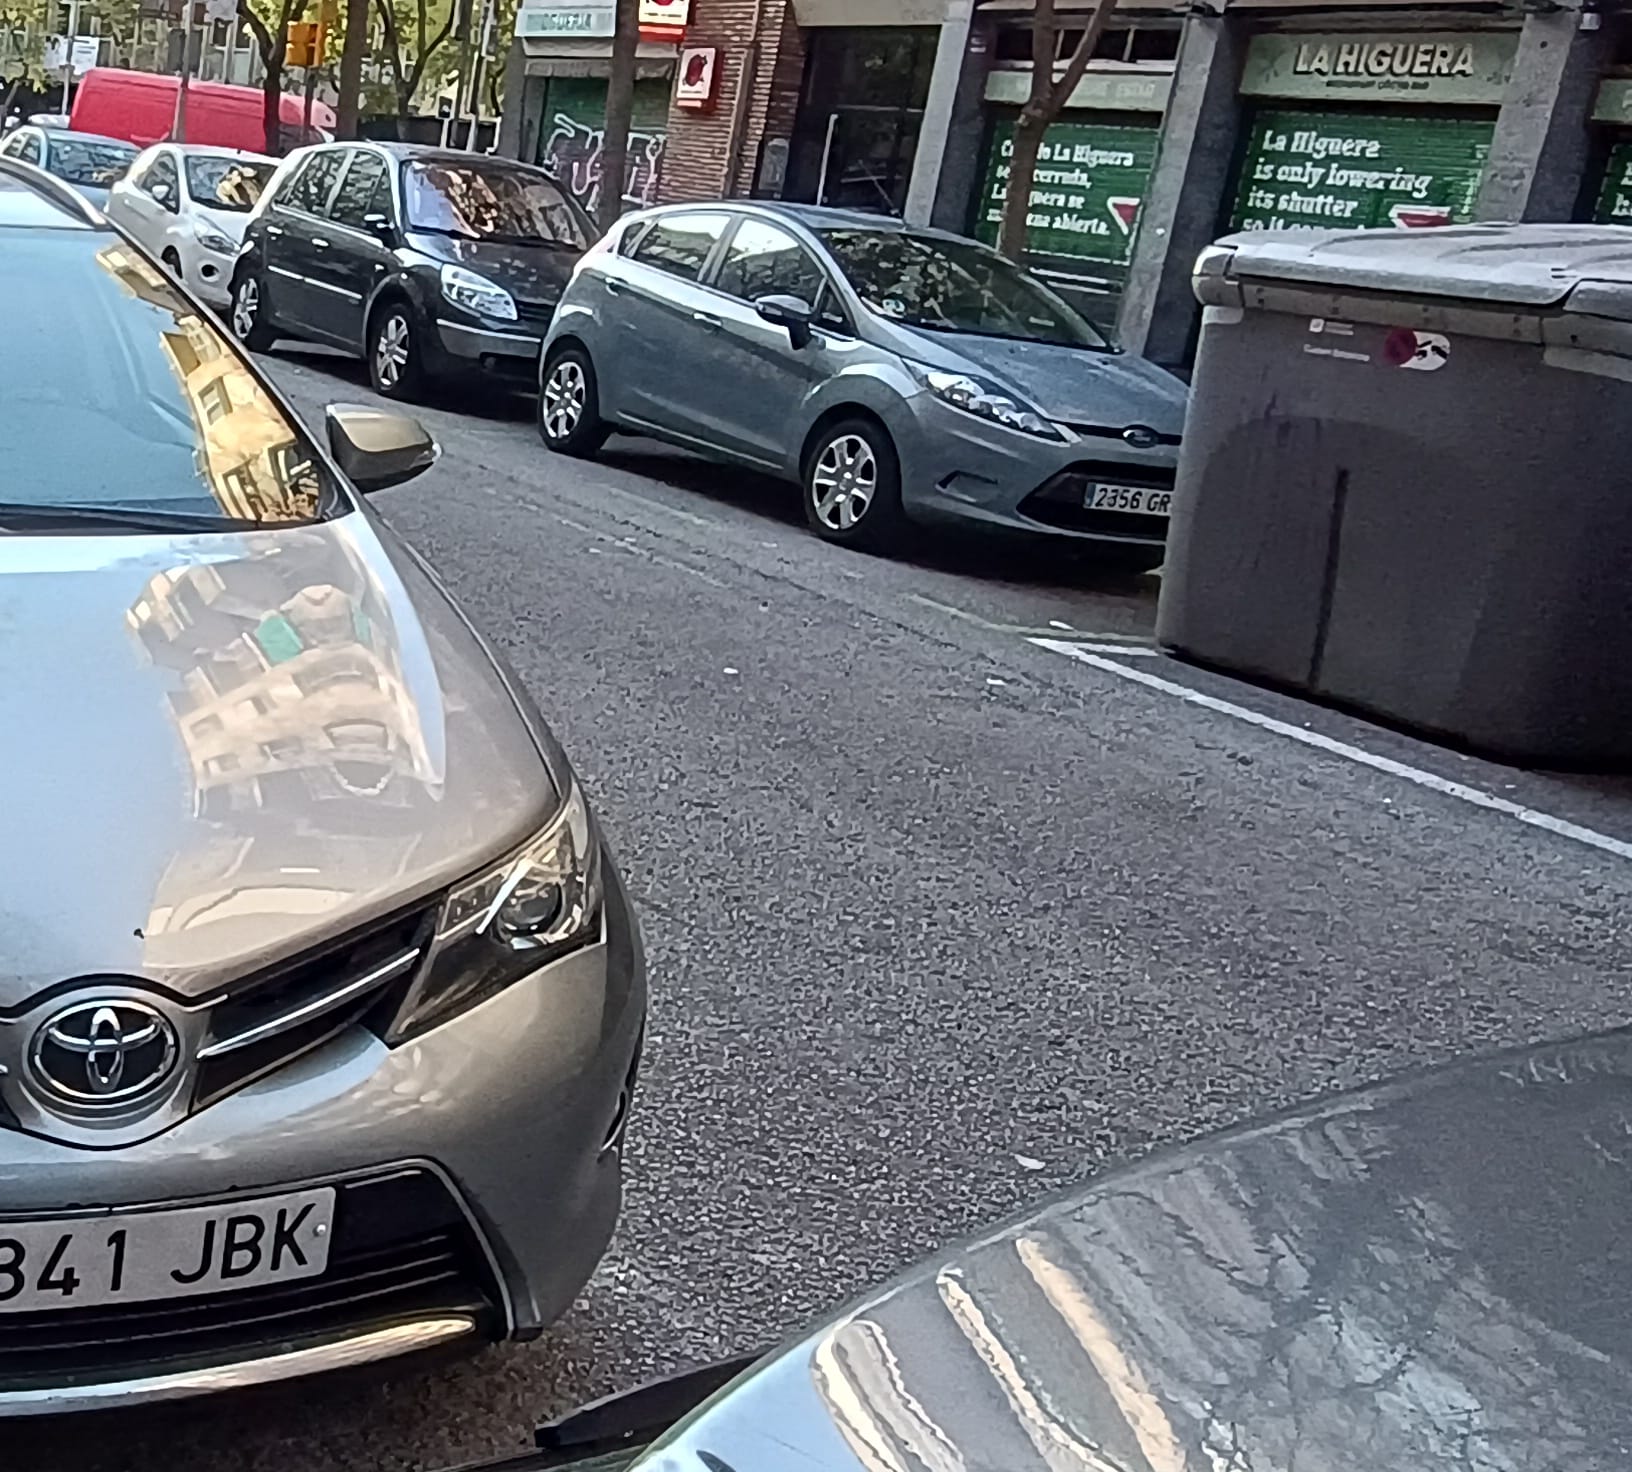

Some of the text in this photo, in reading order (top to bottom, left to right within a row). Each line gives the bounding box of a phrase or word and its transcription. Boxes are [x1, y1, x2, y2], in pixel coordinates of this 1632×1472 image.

[1294, 43, 1474, 77] LA HIGUERA
[1262, 130, 1286, 151] La
[1253, 158, 1433, 199] is only lowering
[1248, 186, 1358, 218] its shutter
[1095, 487, 1171, 513] 2356 GR
[170, 1203, 316, 1285] JBK
